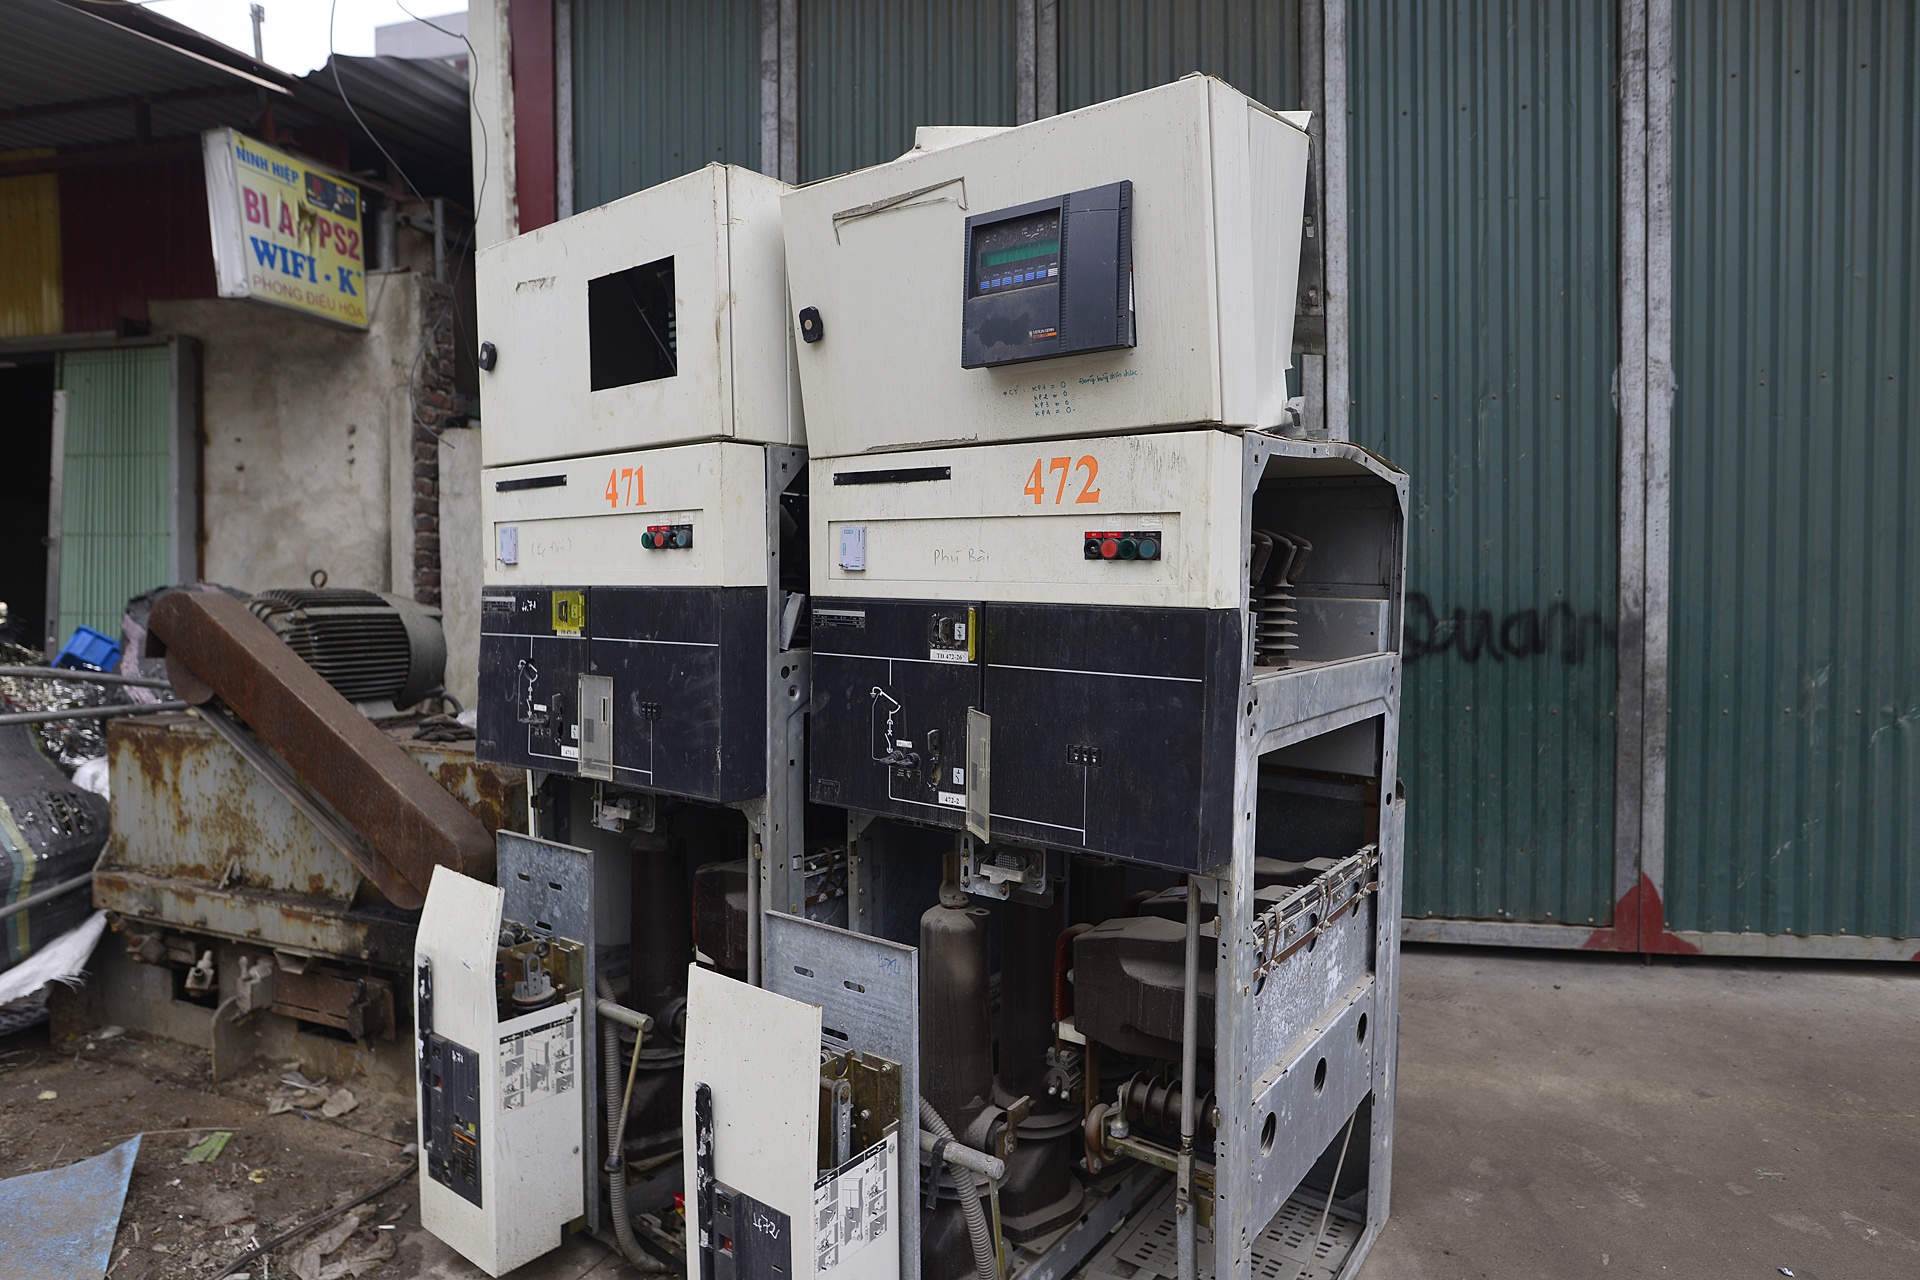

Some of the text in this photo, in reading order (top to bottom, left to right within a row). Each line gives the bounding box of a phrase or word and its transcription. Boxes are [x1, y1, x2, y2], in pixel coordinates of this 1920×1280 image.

[236, 146, 269, 171] NINH
[243, 186, 271, 229] BI
[318, 215, 361, 261] PS2
[250, 237, 318, 284] WIFI
[605, 465, 647, 508] 471
[1023, 454, 1101, 505] 472
[944, 796, 960, 805] 472-2
[752, 1212, 780, 1240] 472
